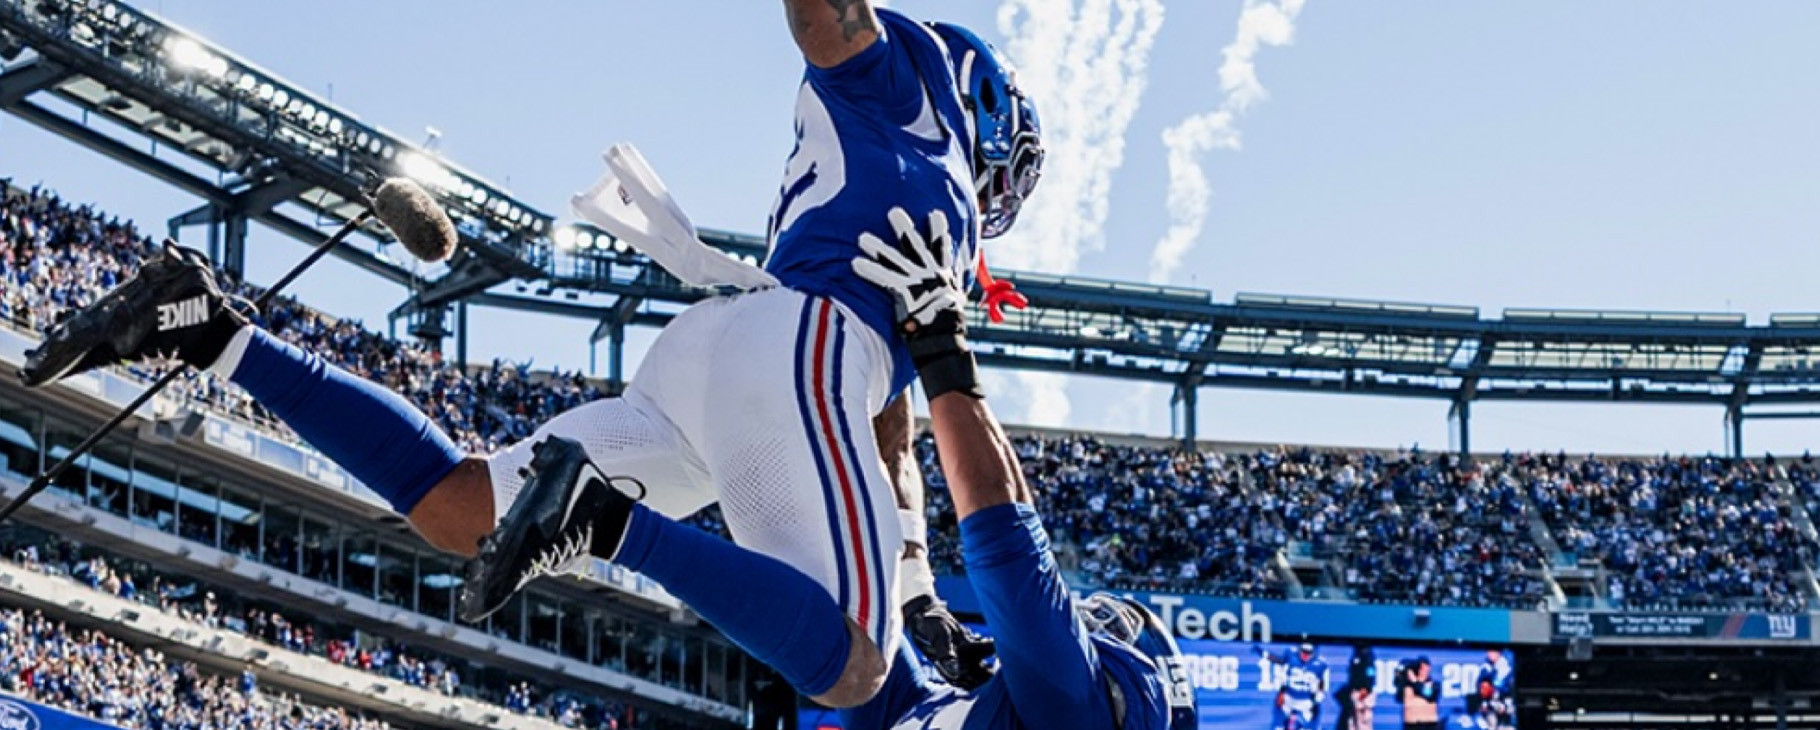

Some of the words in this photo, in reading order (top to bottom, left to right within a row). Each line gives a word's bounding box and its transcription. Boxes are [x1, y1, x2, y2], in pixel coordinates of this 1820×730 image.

[157, 294, 209, 332] NIKE
[1150, 595, 1272, 643] Tech
[1181, 655, 1239, 690] 986
